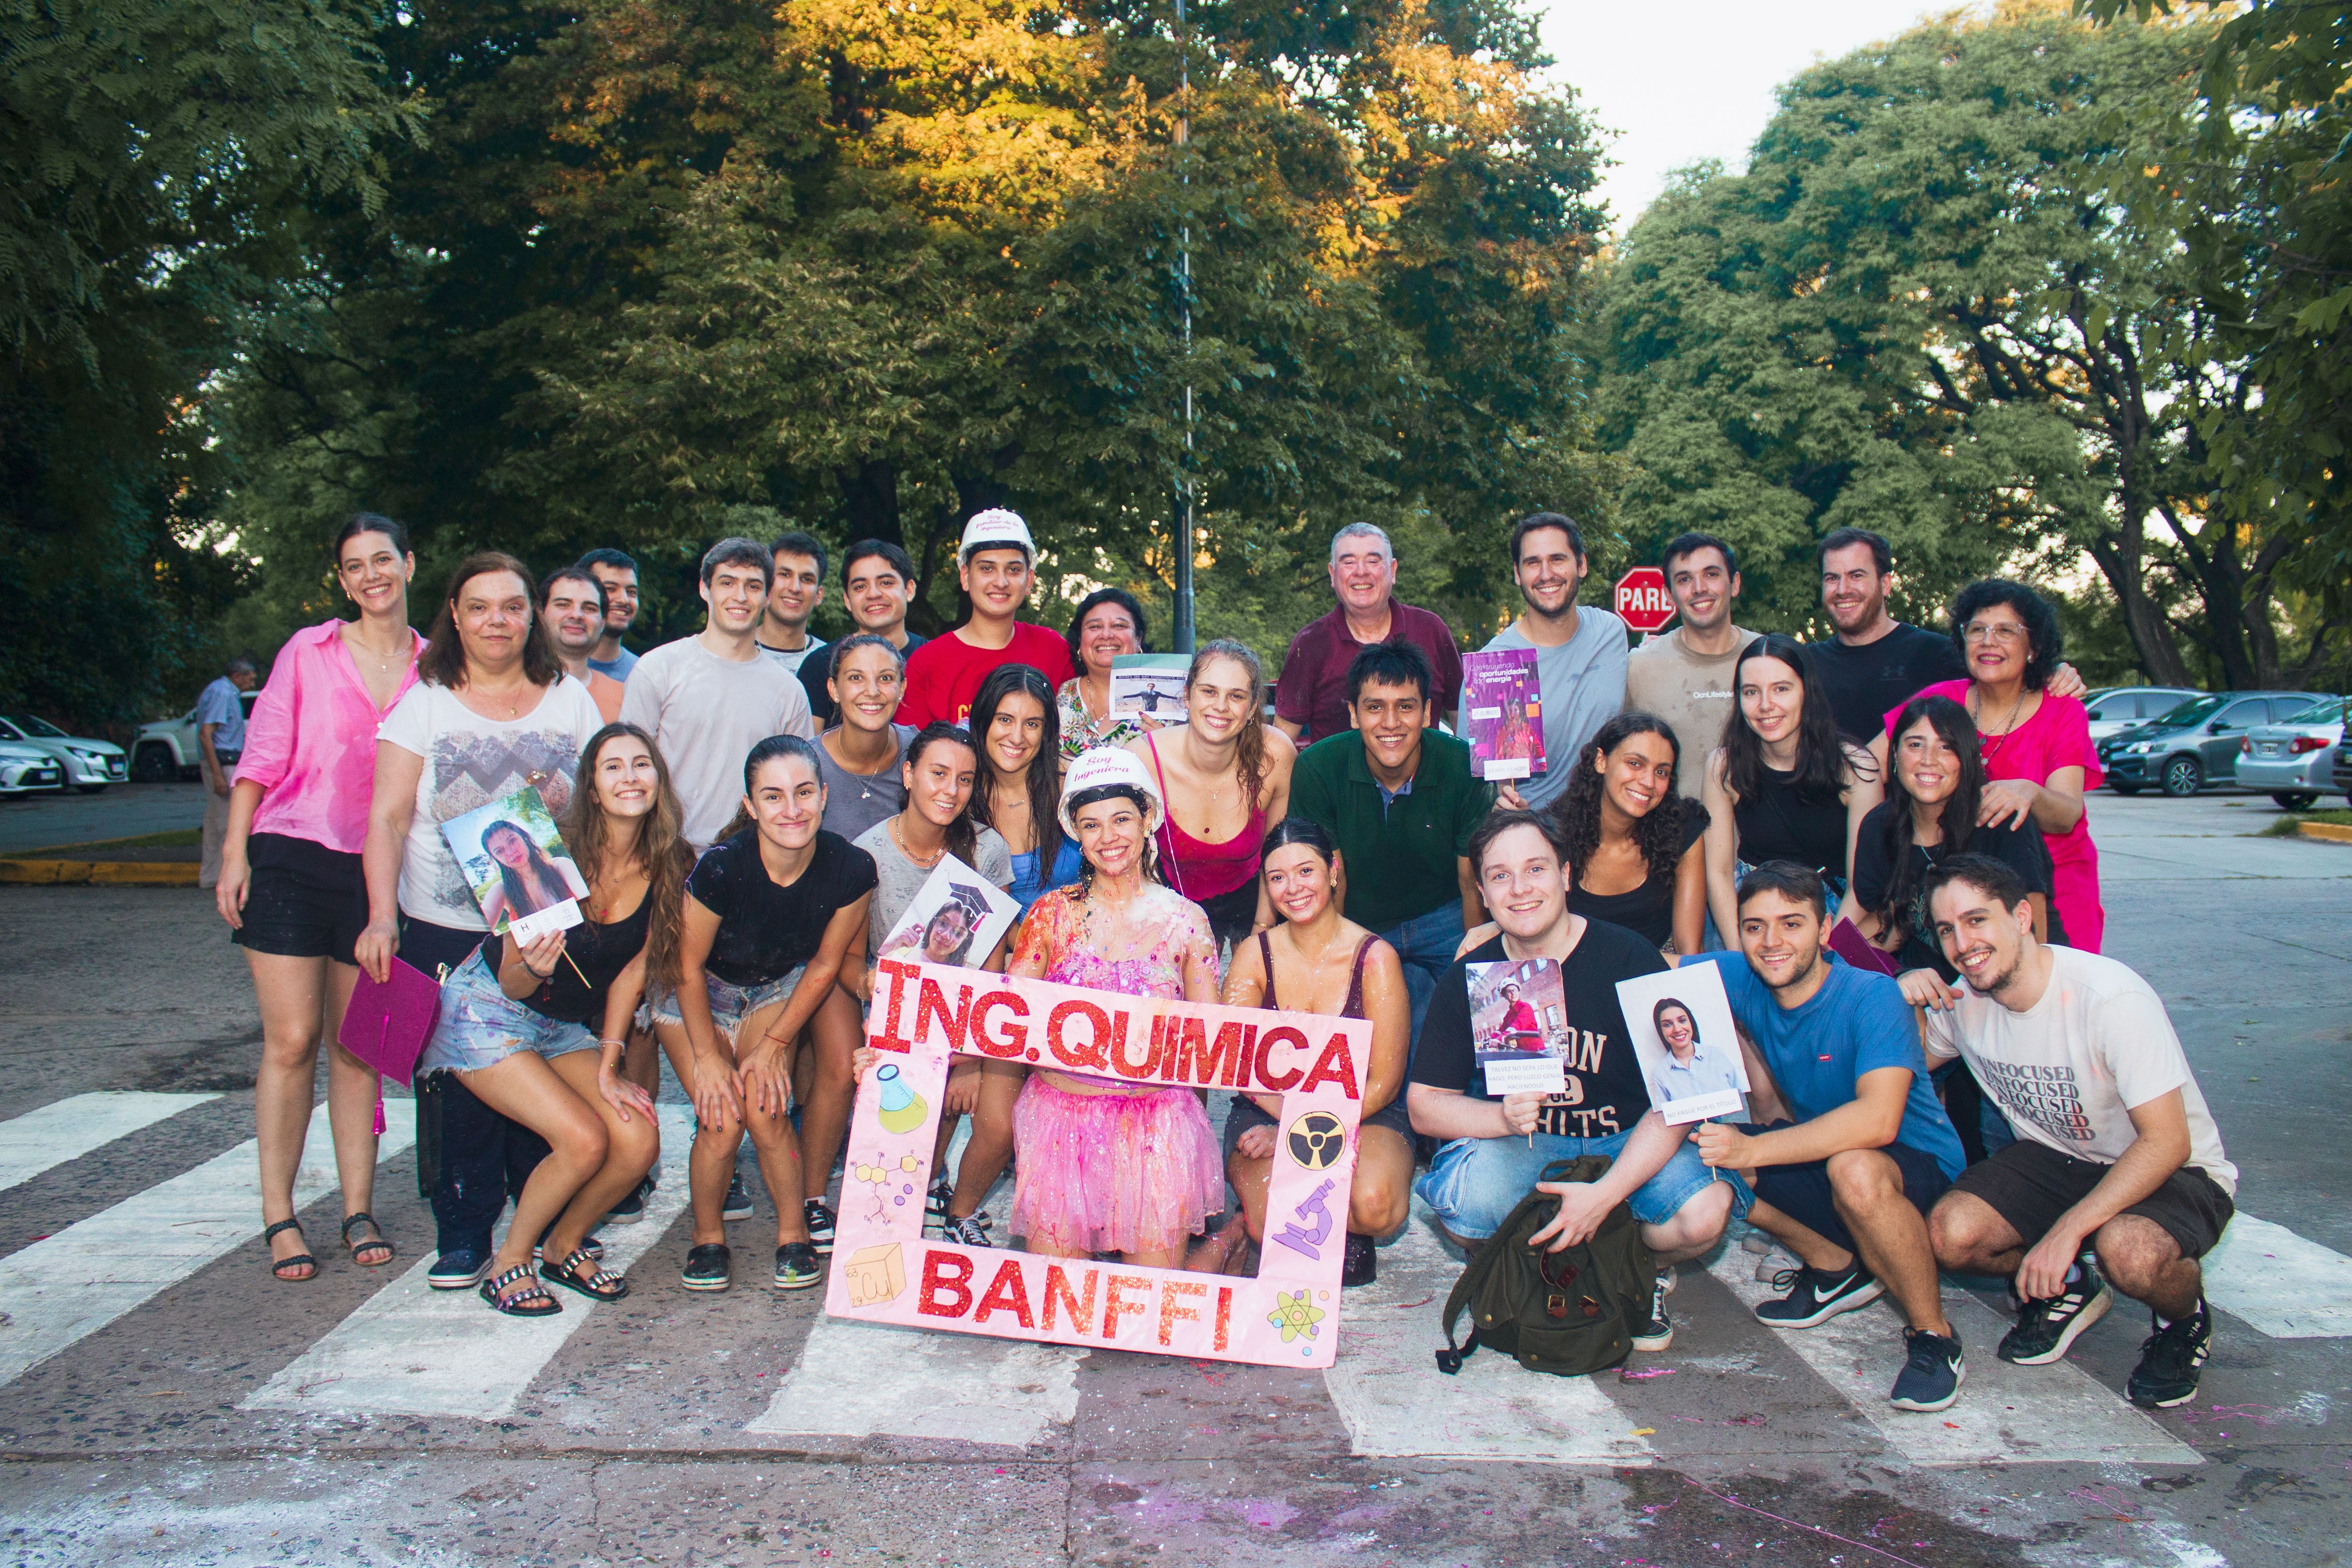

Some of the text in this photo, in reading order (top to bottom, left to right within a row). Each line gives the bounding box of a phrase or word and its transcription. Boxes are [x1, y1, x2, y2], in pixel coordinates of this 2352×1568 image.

[1469, 662, 1515, 671] Construyendo
[1479, 668, 1529, 678] oportunidades
[1087, 756, 1112, 766] Soy
[1074, 765, 1130, 782] Ingeniera
[1977, 1055, 2075, 1082] UNFOCUSED
[1677, 1108, 1696, 1116] PAGUÉ
[1717, 1099, 1736, 1108] TÍTULO
[846, 1268, 858, 1278] 63
[862, 1272, 891, 1300] Cu
[852, 1296, 863, 1308] 29
[918, 1249, 1232, 1353] BANFFI
